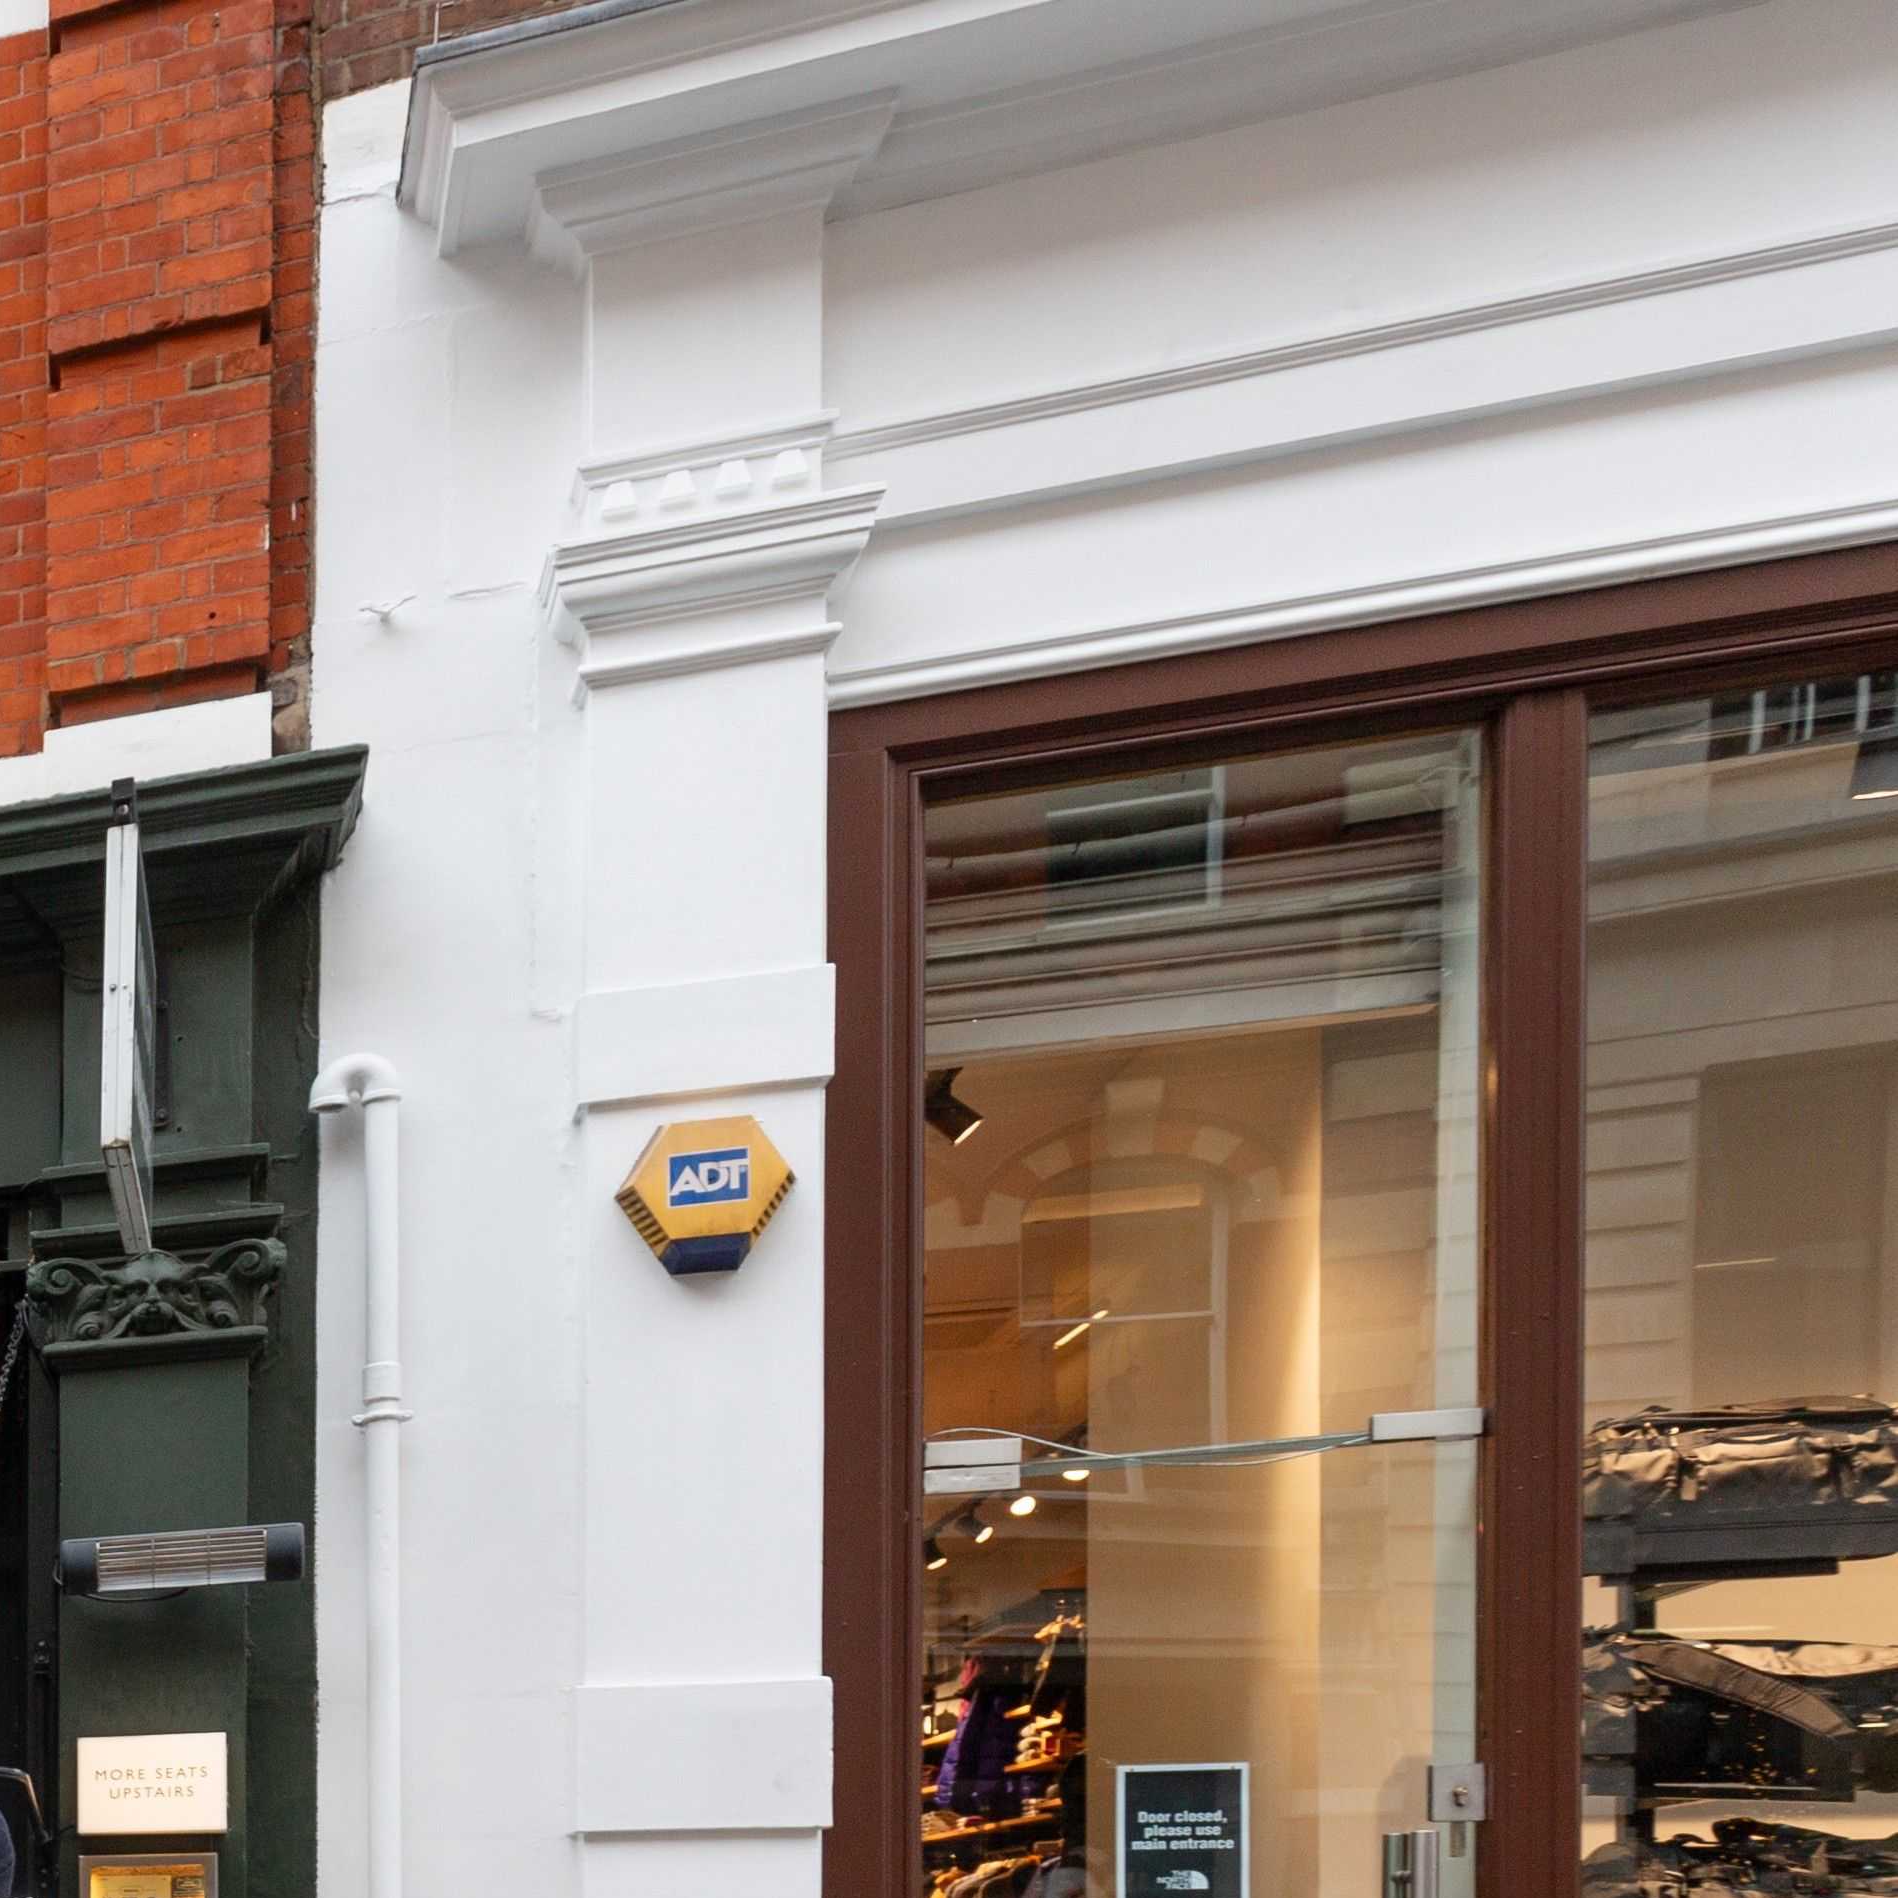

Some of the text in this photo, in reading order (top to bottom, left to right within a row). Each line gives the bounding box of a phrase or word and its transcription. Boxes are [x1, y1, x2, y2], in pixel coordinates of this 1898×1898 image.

[669, 1158, 749, 1196] ADT
[94, 1765, 209, 1781] MORE SEATS
[109, 1785, 196, 1800] UPSTAIRS
[1137, 1809, 1228, 1824] Door closed,
[1143, 1825, 1222, 1839] please use
[1131, 1838, 1235, 1850] main entrance
